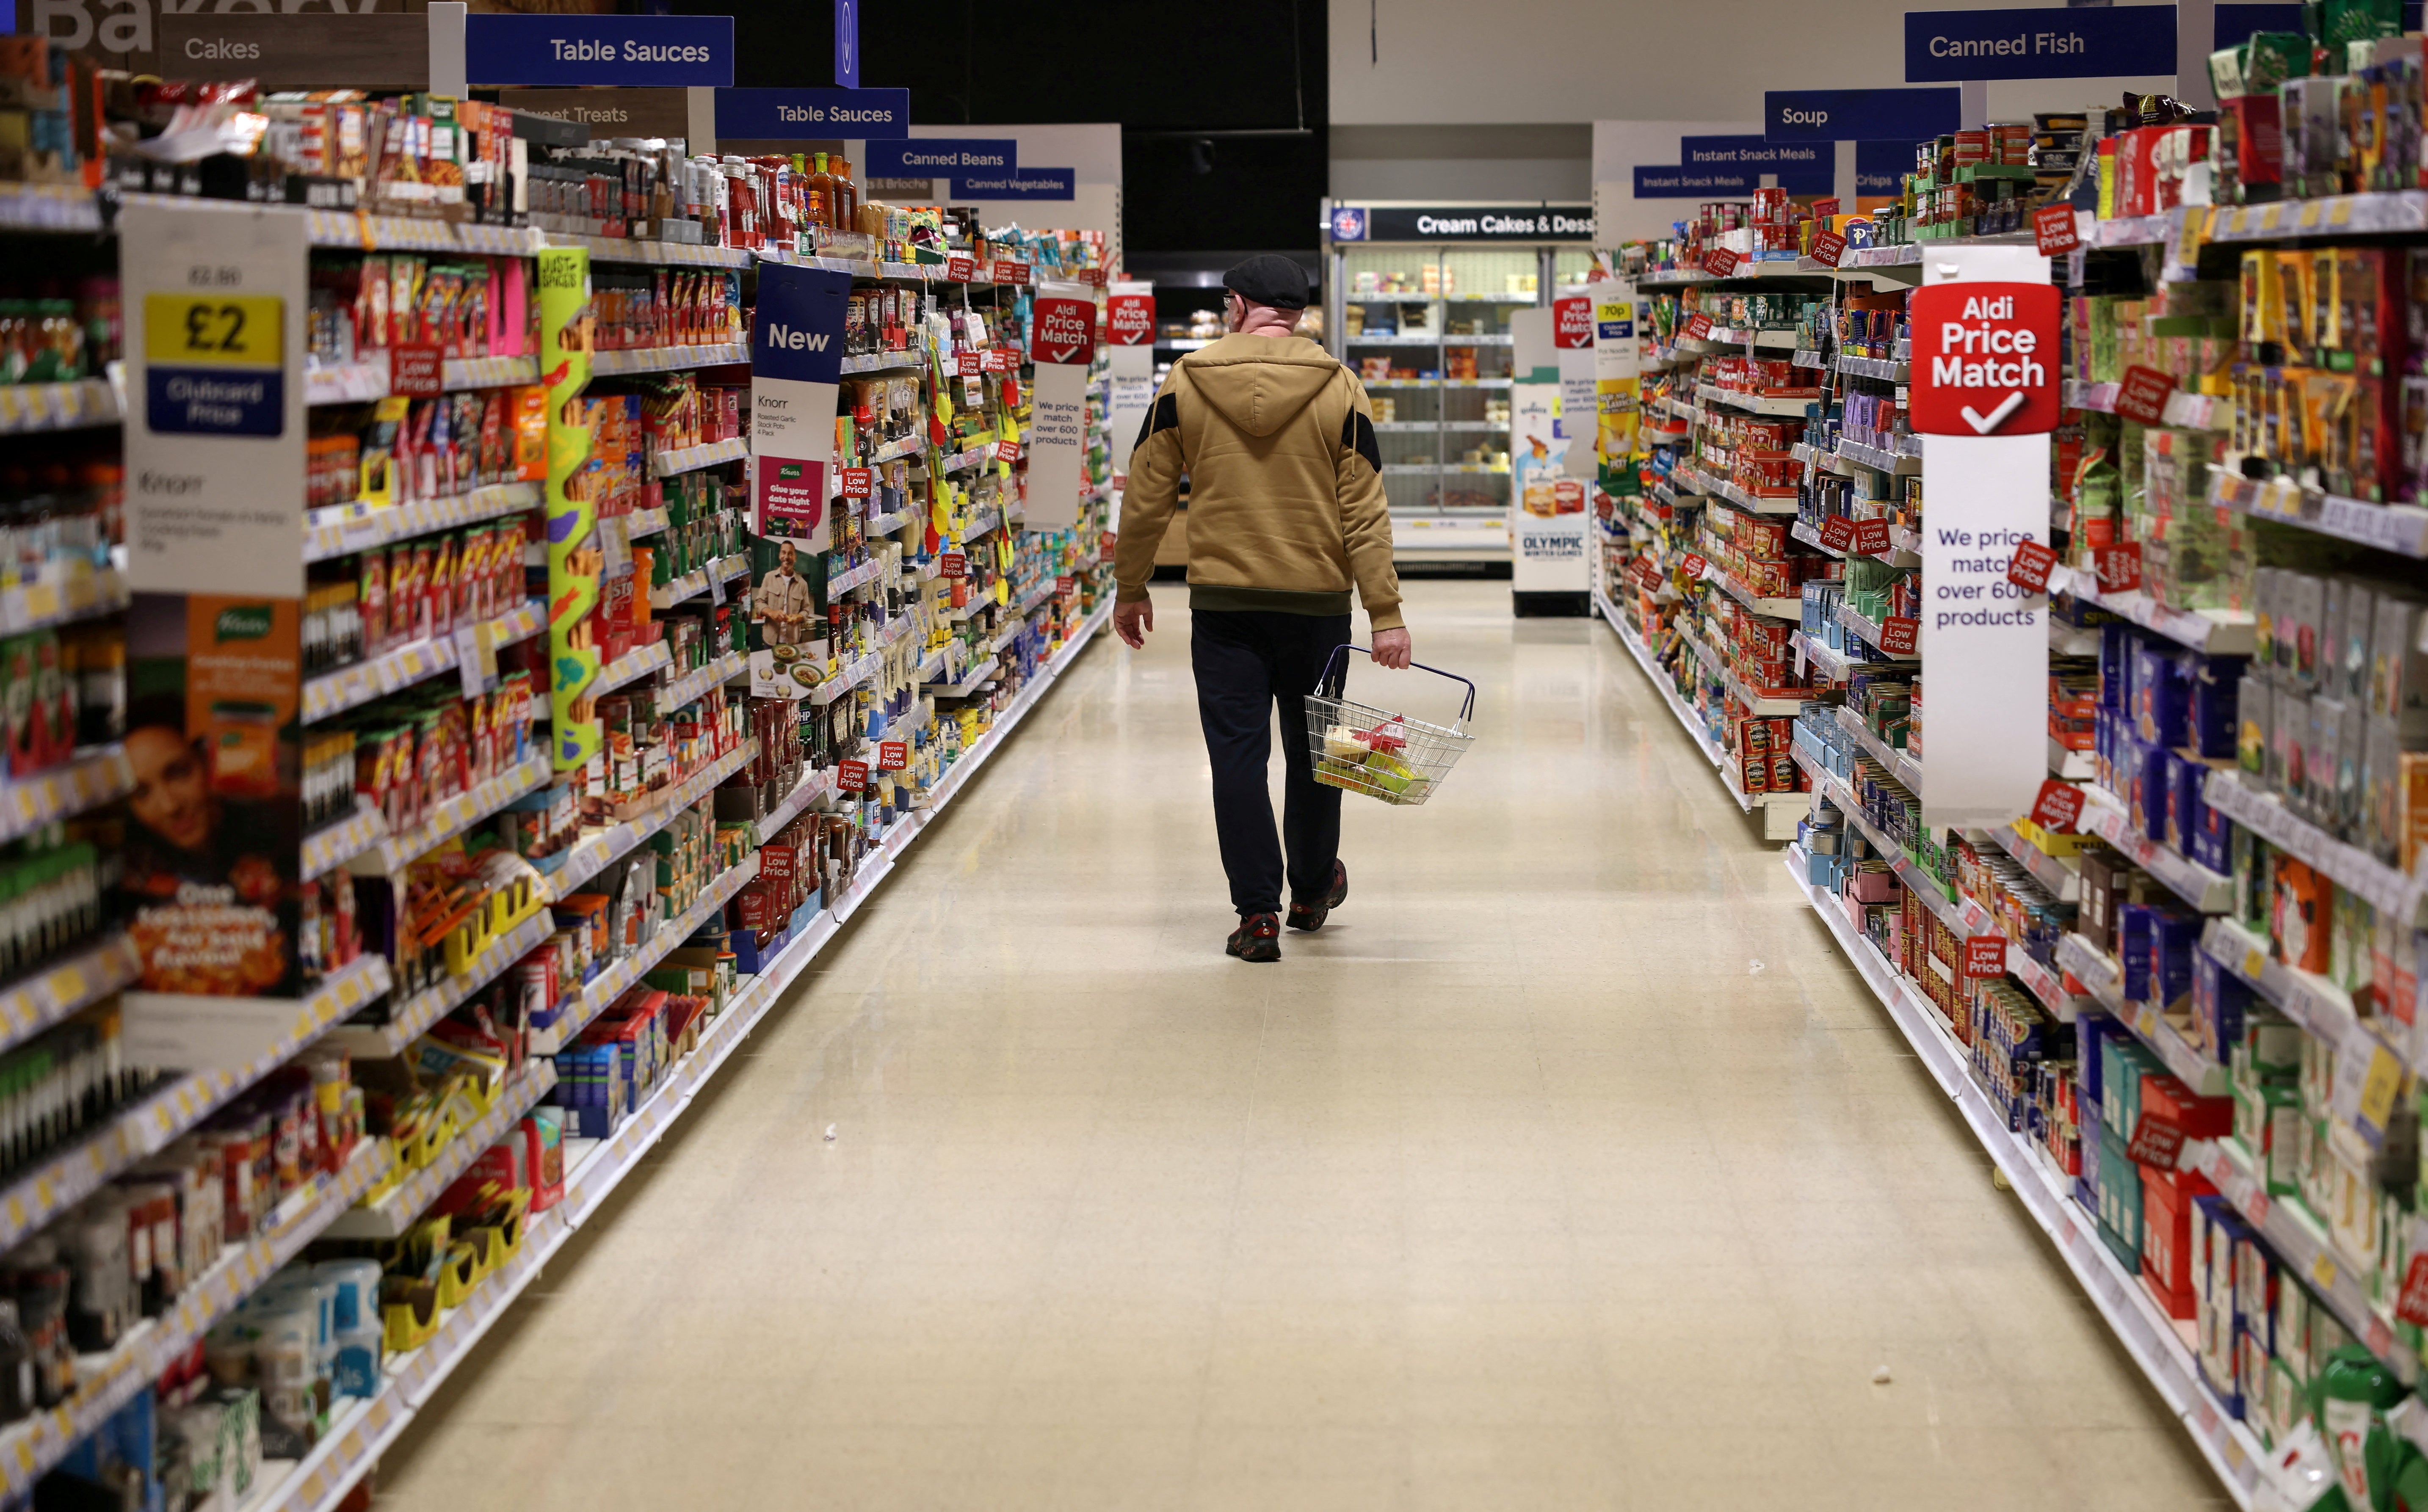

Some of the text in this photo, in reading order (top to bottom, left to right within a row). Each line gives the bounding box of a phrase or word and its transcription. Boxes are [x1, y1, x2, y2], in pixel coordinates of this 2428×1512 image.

[185, 38, 260, 60] Cakes
[1929, 32, 2085, 57] Canned Fish
[550, 39, 710, 63] Table Sauces
[574, 107, 628, 123] Treats
[777, 106, 892, 122] Table Sauces
[1782, 108, 1828, 127] Soup
[903, 152, 1004, 166] Canned Beans
[1693, 149, 1815, 161] Instant Snack Meals
[887, 179, 928, 190] Brioche
[966, 179, 1064, 192] Canned Vegetables
[1643, 176, 1745, 187] Instant Snack Meals
[1856, 174, 1892, 188] Crisps
[1417, 215, 1477, 234] Cream
[1481, 215, 1535, 234] Cakes
[1537, 216, 1550, 233] &
[2041, 220, 2069, 236] Low
[1820, 239, 1838, 253] Low
[1822, 234, 1842, 246] Everyday
[2040, 232, 2074, 251] Price
[1719, 255, 1733, 265] Low
[1814, 247, 1837, 262] Price
[953, 265, 968, 273] Low
[1714, 260, 1731, 273] Price
[951, 271, 969, 280] Price
[1123, 298, 1140, 308] Aldi
[1961, 295, 2014, 320] Aldi
[1055, 304, 1077, 316] Aldi
[1115, 308, 1148, 320] Price
[1604, 306, 1625, 317] 70p
[185, 303, 248, 353] £2
[1045, 314, 1085, 331] Price
[1112, 318, 1151, 331] Match
[1693, 322, 1707, 330] Low
[768, 323, 830, 352] New
[1041, 328, 1088, 345] Match
[1690, 326, 1706, 337] Price
[1942, 320, 2036, 355] Price
[1932, 354, 2045, 388] Match
[758, 395, 788, 409] Knorr
[1039, 401, 1079, 412] We price
[757, 413, 779, 421] Roasted
[1044, 414, 1072, 422] match
[1060, 425, 1078, 434] 600
[1036, 436, 1077, 446] products
[999, 451, 1015, 461] Price
[1002, 446, 1016, 454] Low
[780, 468, 800, 476] Knorr
[770, 484, 789, 494] Give
[845, 486, 868, 494] Price
[768, 495, 810, 506] date night
[1829, 524, 1848, 537] Low
[1831, 519, 1853, 530] Everyday
[1823, 532, 1847, 547] Price
[1862, 530, 1883, 540] Low
[1937, 527, 2035, 549] We price
[1524, 537, 1583, 549] OLYMPIC
[1860, 540, 1887, 551] Price
[2019, 552, 2047, 572] Low
[2011, 563, 2044, 586] Price
[1937, 585, 1985, 599] over
[1936, 607, 2035, 630] products
[1888, 621, 1914, 630] Everyday
[1888, 627, 1911, 639] Low
[1884, 637, 1912, 650] Price
[799, 711, 810, 721] HP
[843, 764, 865, 772] Everyday
[883, 758, 904, 767] Price
[843, 770, 862, 779] Low
[840, 778, 864, 788] Price
[874, 805, 881, 817] HP
[767, 857, 788, 866] Low
[763, 866, 790, 877] Price
[1972, 949, 1999, 960] Low
[1969, 960, 2002, 973] Price
